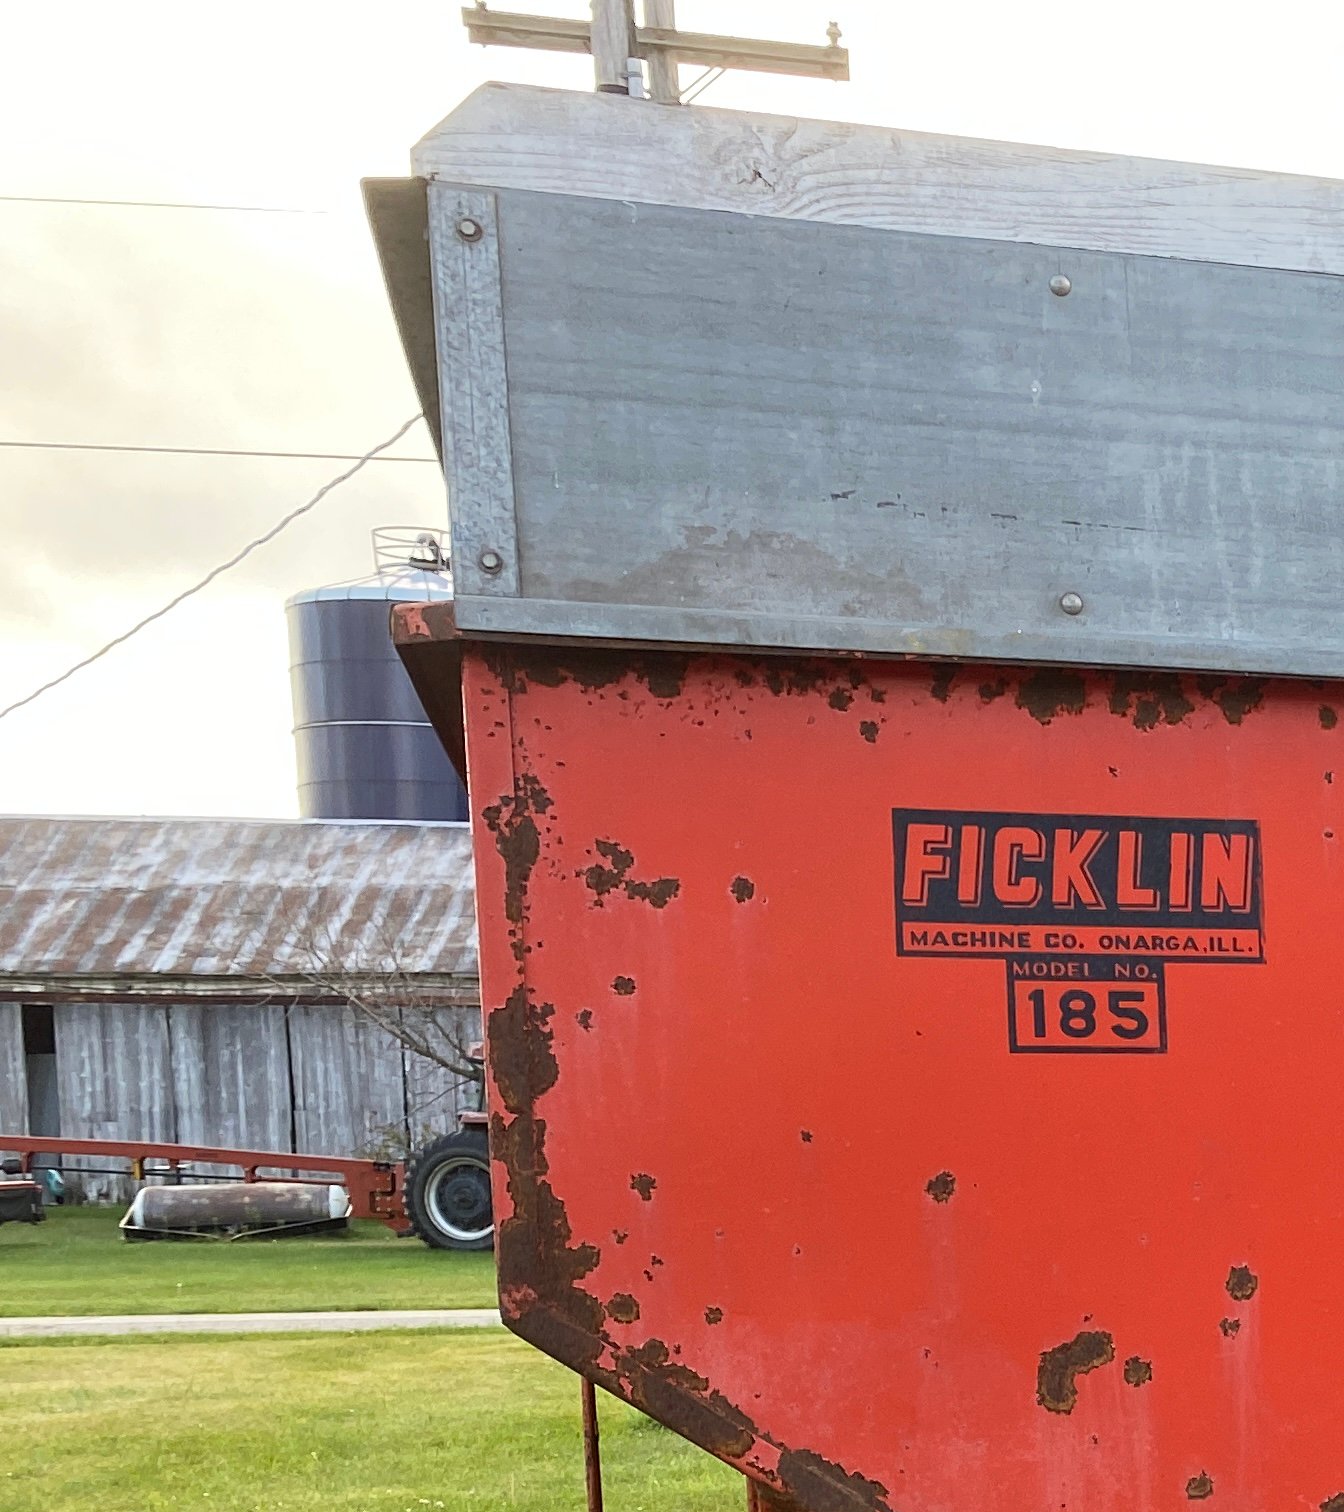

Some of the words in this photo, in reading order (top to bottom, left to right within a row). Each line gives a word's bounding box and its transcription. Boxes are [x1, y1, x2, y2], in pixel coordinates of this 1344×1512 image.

[902, 823, 1254, 913] FICKLIN
[910, 930, 1032, 949] MACHINE
[1044, 932, 1086, 950] CO.
[1012, 961, 1090, 978] MODEL
[1114, 962, 1158, 979] NO.
[1027, 988, 1150, 1040] 185
